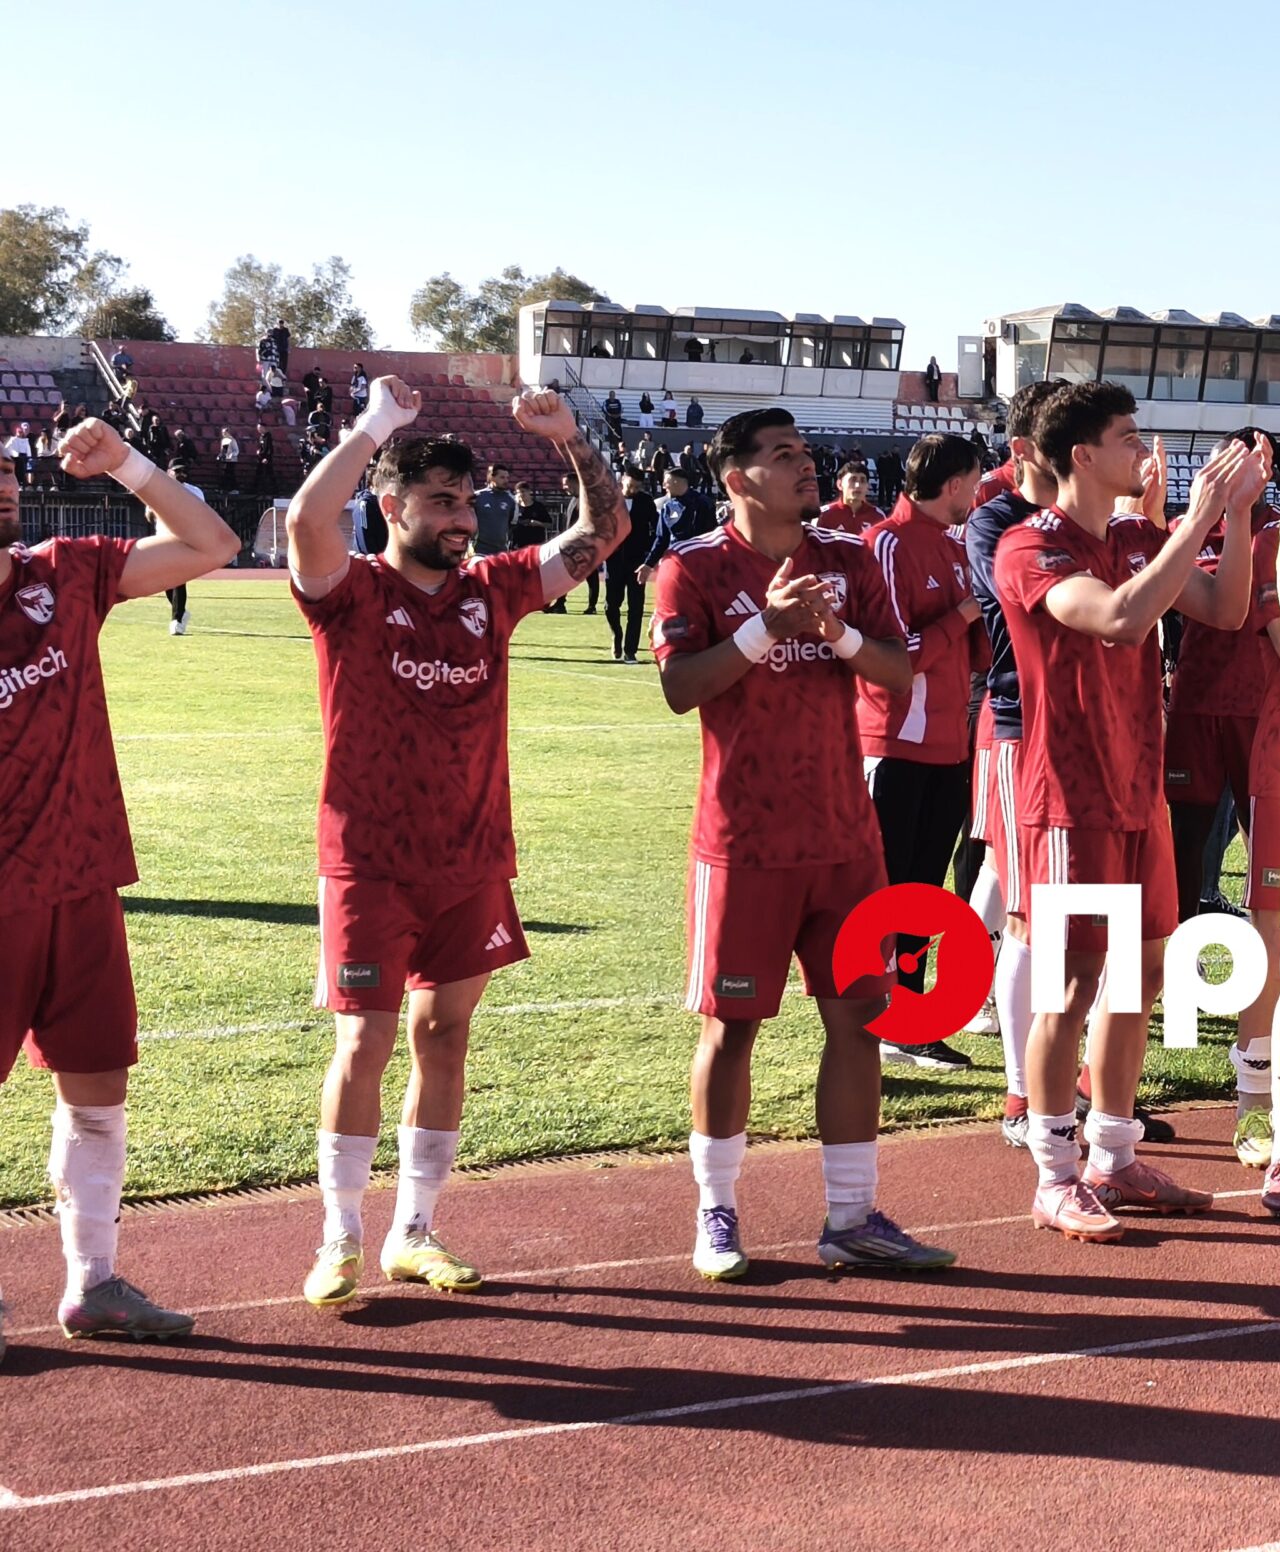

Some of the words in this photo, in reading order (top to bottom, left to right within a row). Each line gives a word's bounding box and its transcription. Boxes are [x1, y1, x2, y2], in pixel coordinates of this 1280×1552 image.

[392, 651, 488, 690] logitech
[761, 637, 837, 672] gitec
[0, 645, 69, 709] gitech
